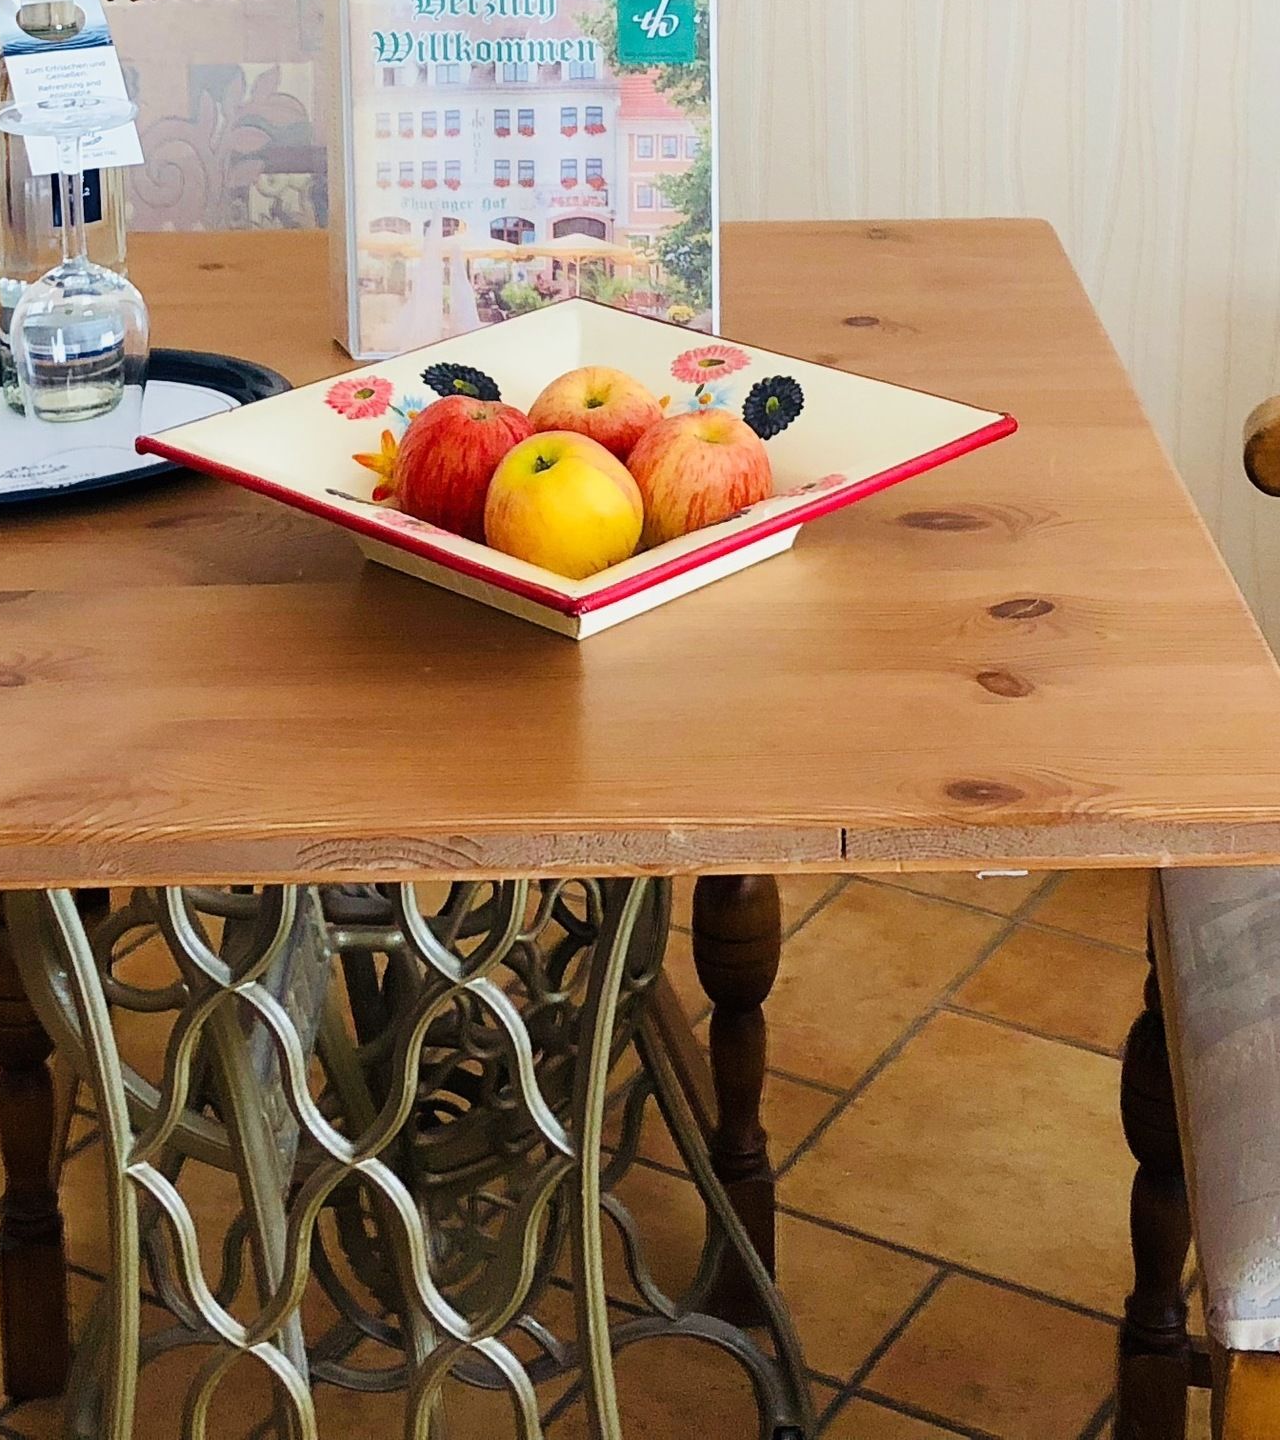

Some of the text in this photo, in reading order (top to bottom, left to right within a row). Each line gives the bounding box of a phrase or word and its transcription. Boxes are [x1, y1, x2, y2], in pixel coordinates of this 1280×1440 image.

[372, 31, 598, 63] Willkommen
[24, 67, 43, 75] Zum
[89, 61, 107, 69] und
[38, 79, 103, 93] Refreshing and
